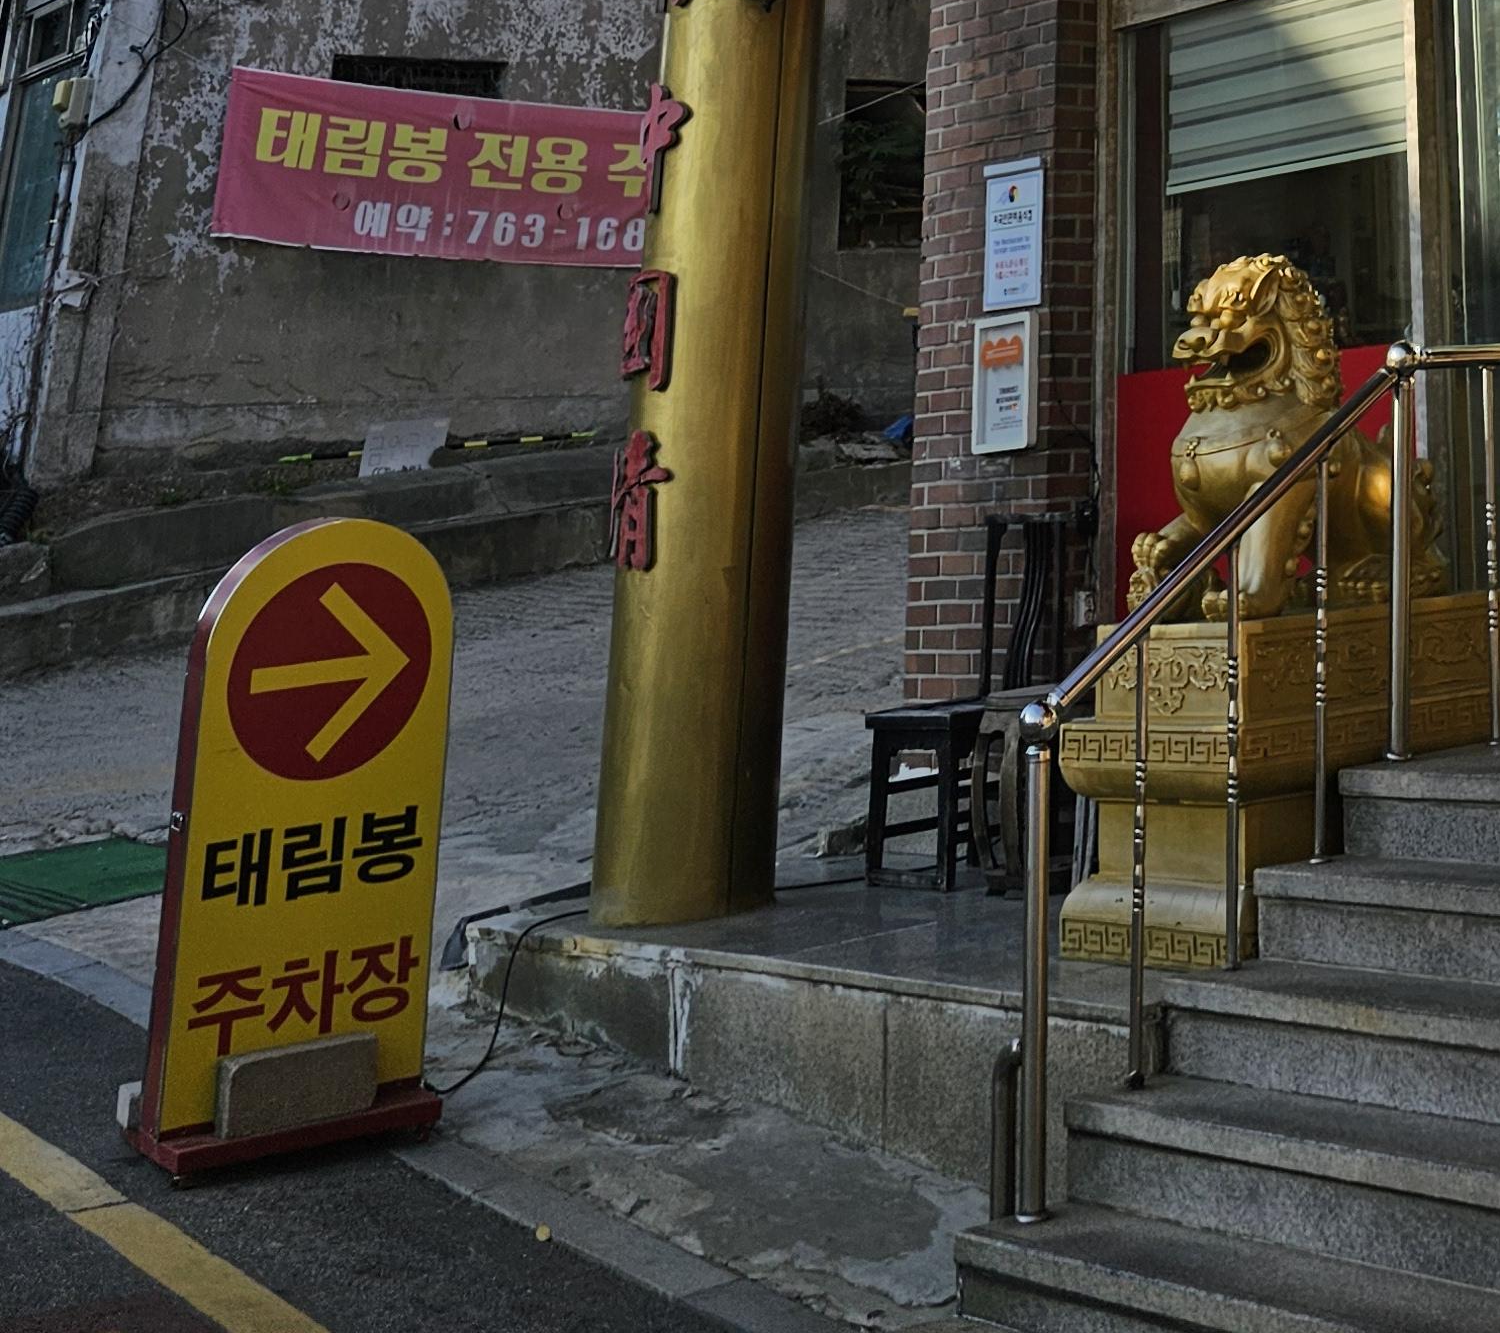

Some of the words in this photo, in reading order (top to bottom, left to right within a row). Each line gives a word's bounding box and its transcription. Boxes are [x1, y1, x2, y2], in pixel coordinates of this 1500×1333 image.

[255, 106, 449, 185] 태림봉
[466, 131, 589, 194] 전용
[201, 804, 423, 908] 태림봉
[187, 934, 420, 1056] 주차장
